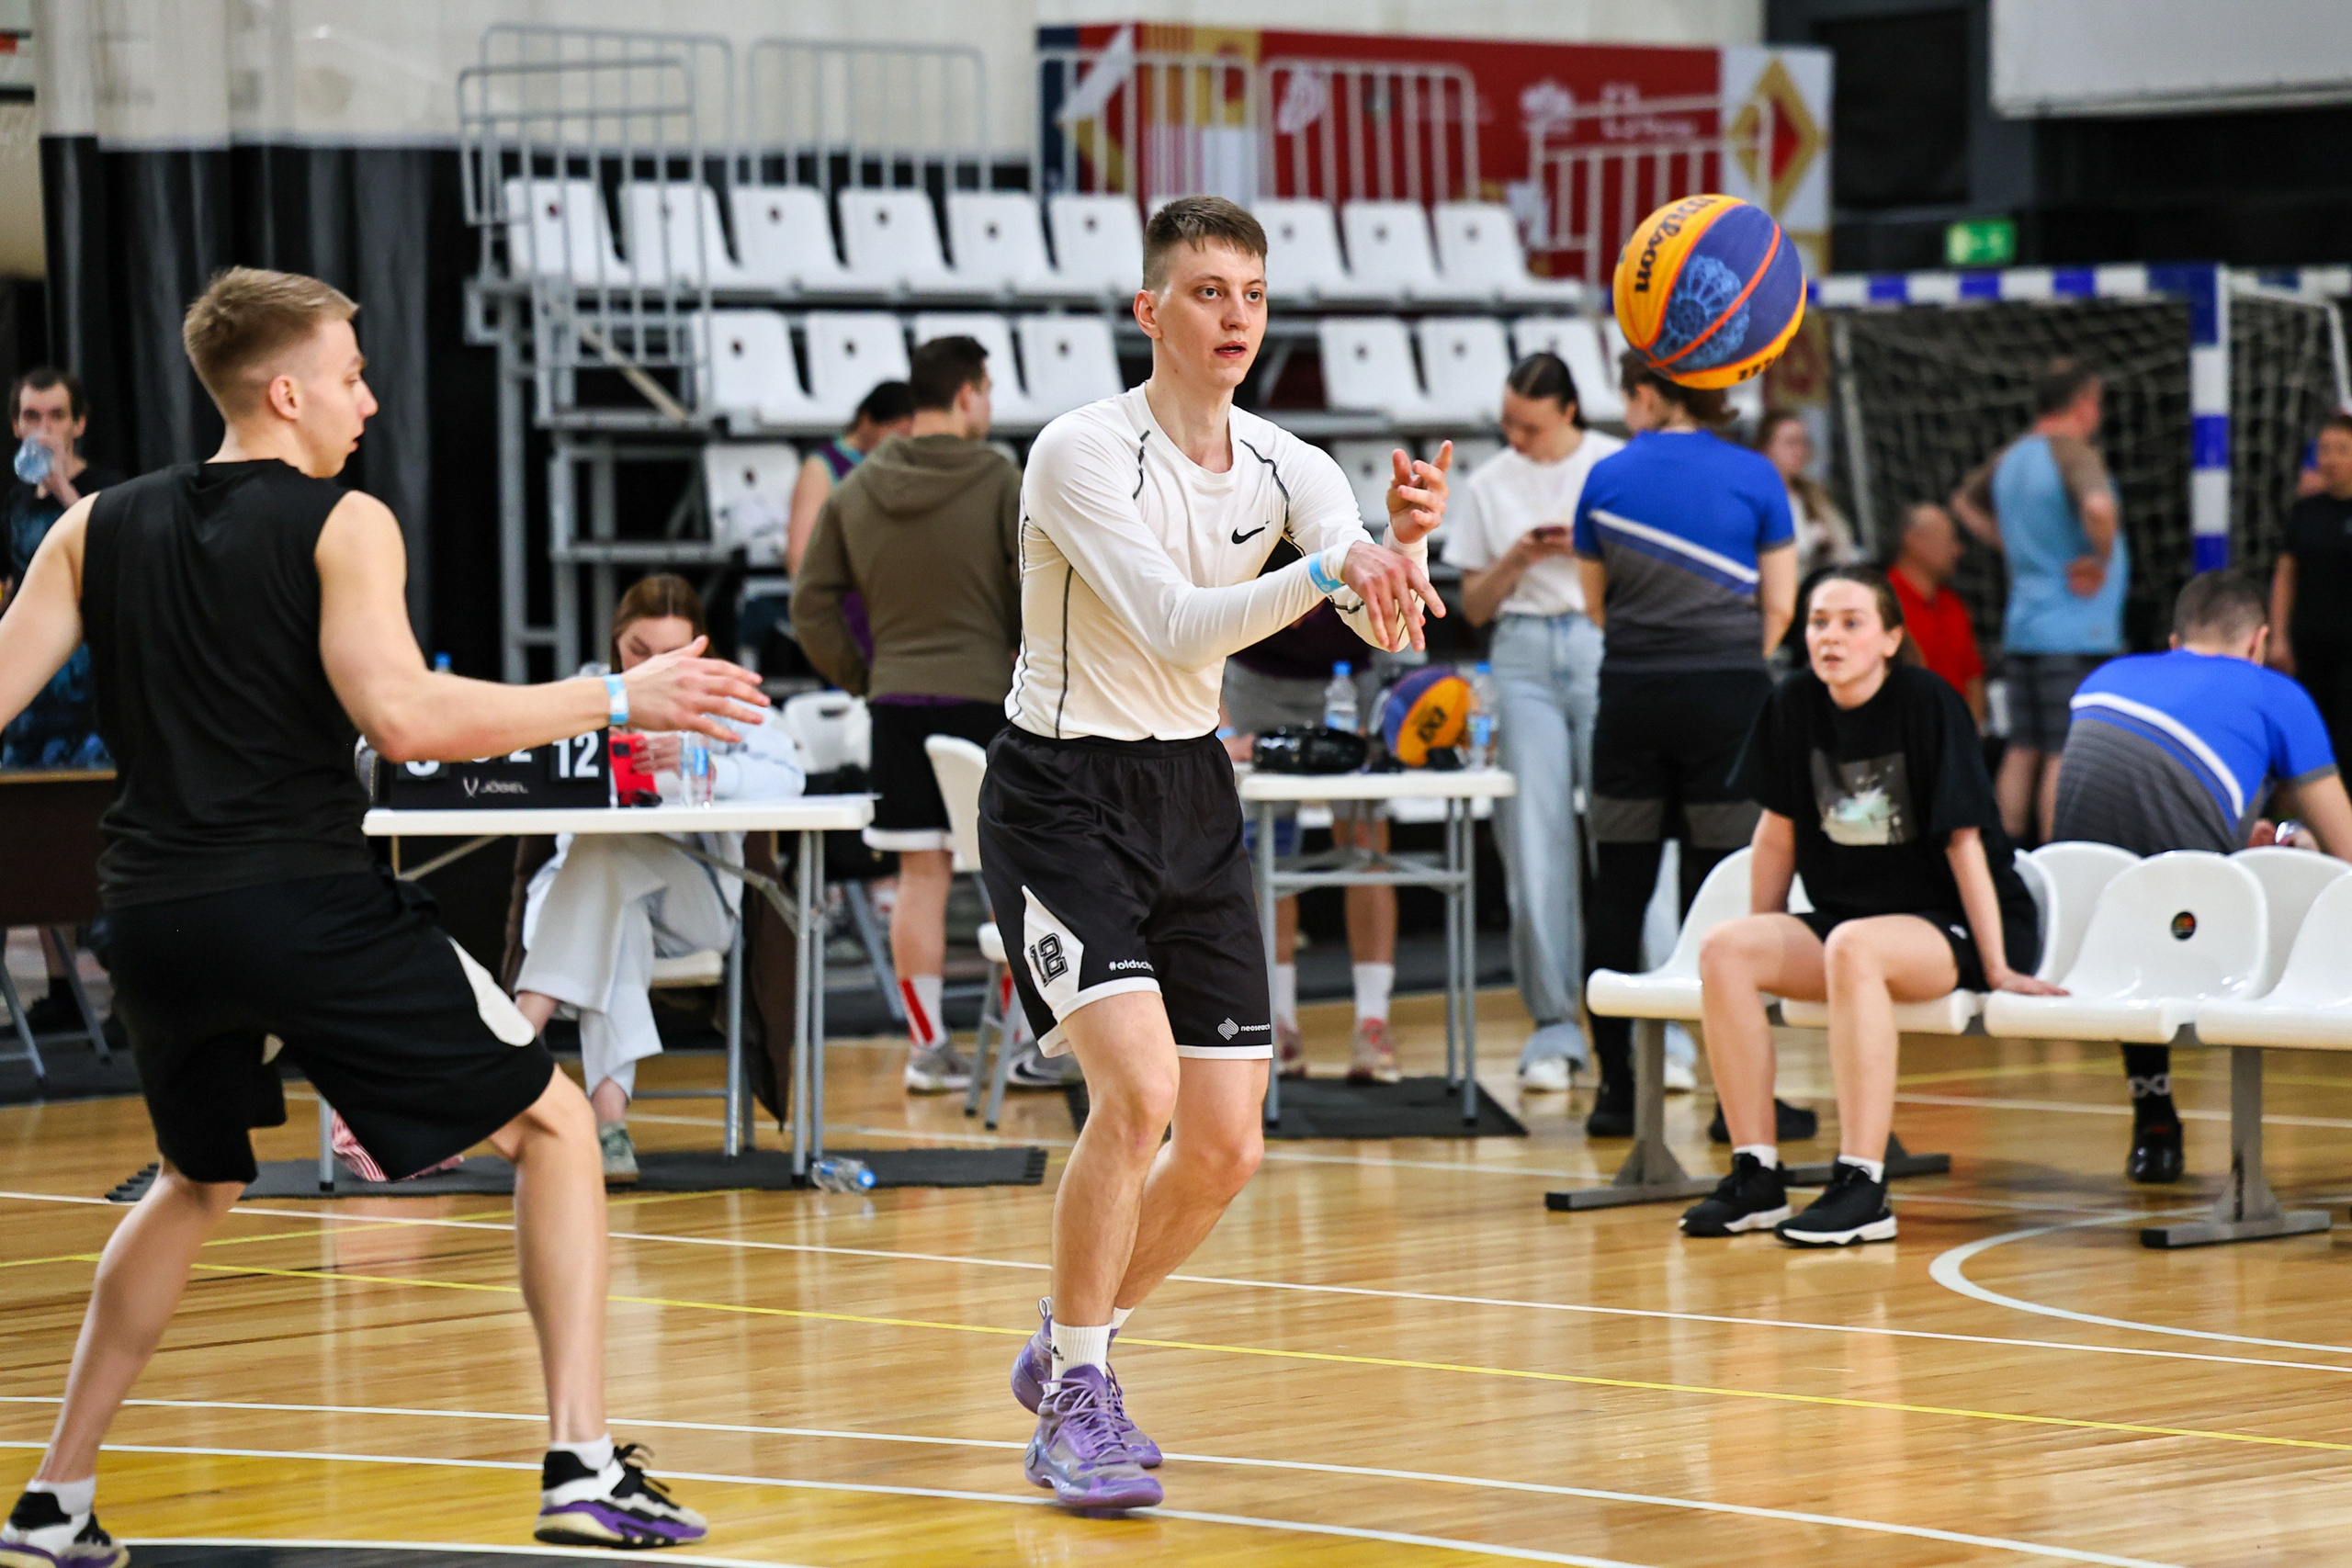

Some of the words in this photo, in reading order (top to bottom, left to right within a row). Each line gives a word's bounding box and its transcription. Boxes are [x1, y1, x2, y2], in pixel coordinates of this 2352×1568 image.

[1634, 195, 1719, 294] Wilson
[552, 730, 600, 779] 12
[1029, 932, 1069, 987] 12
